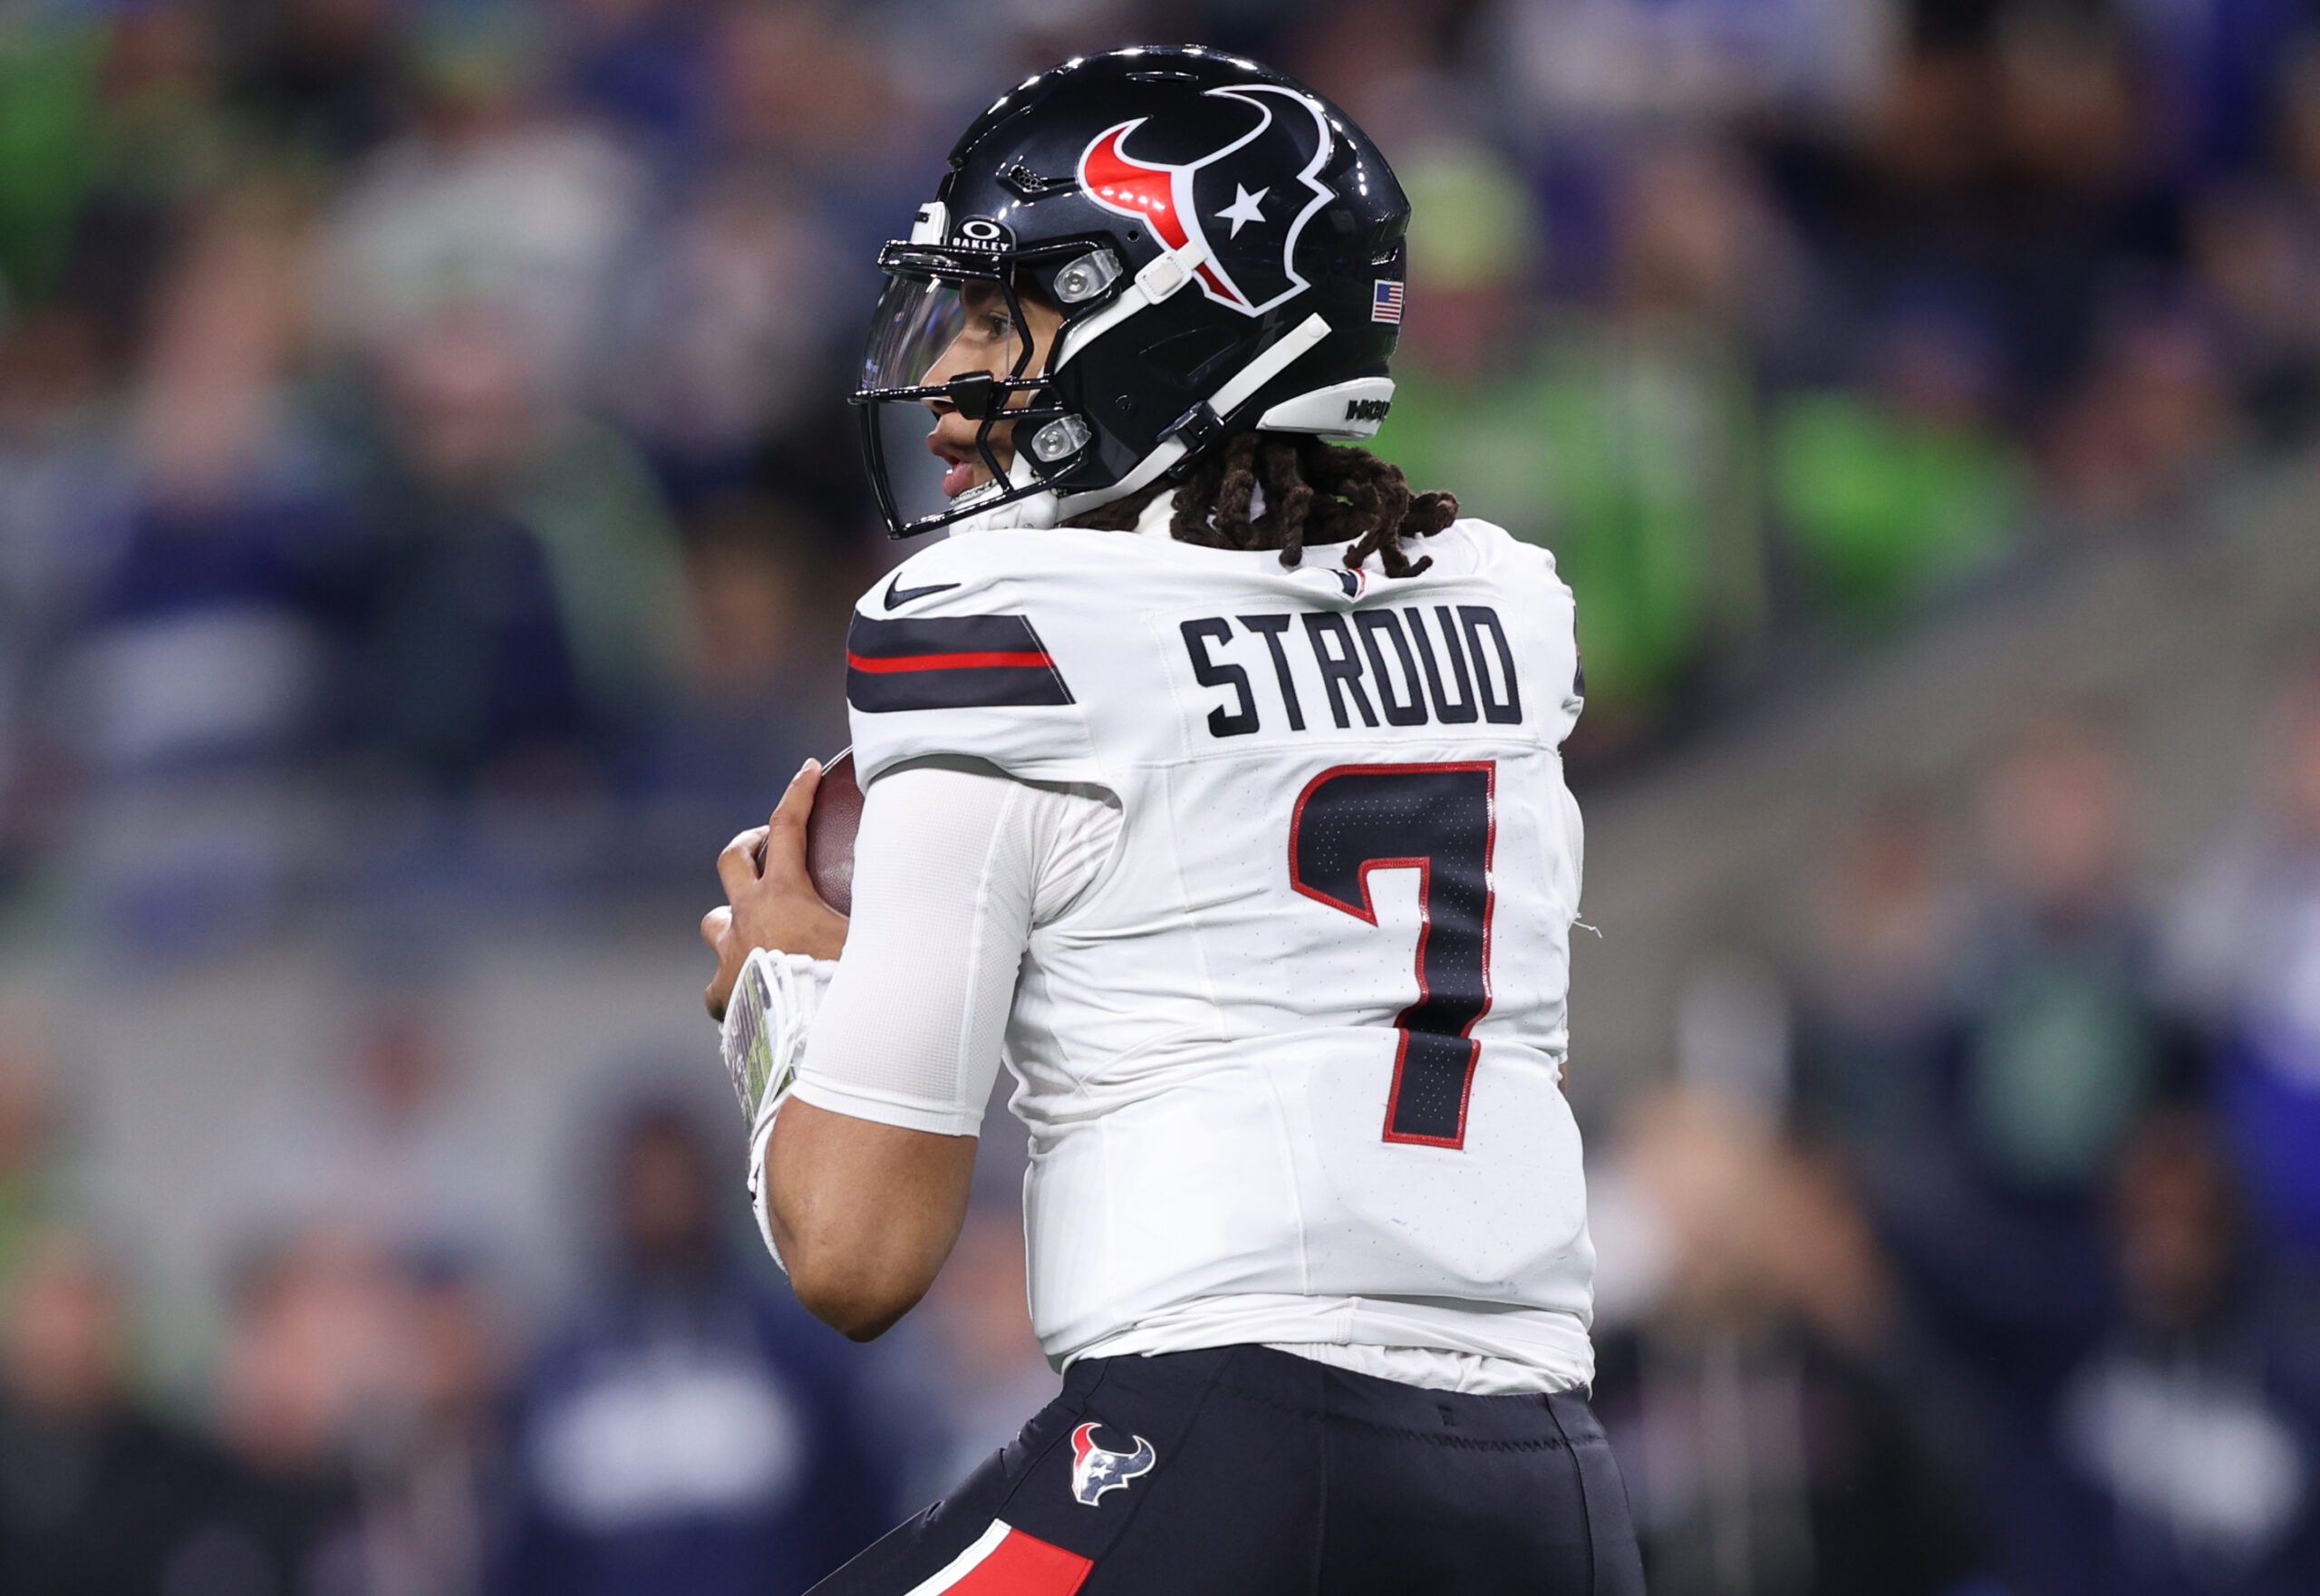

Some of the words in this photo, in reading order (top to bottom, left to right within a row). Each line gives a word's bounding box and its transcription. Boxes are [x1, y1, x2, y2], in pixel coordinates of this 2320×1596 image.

[952, 237, 1010, 251] OAKLEY
[1180, 605, 1522, 738] STROUD
[1288, 759, 1496, 1150] 7
